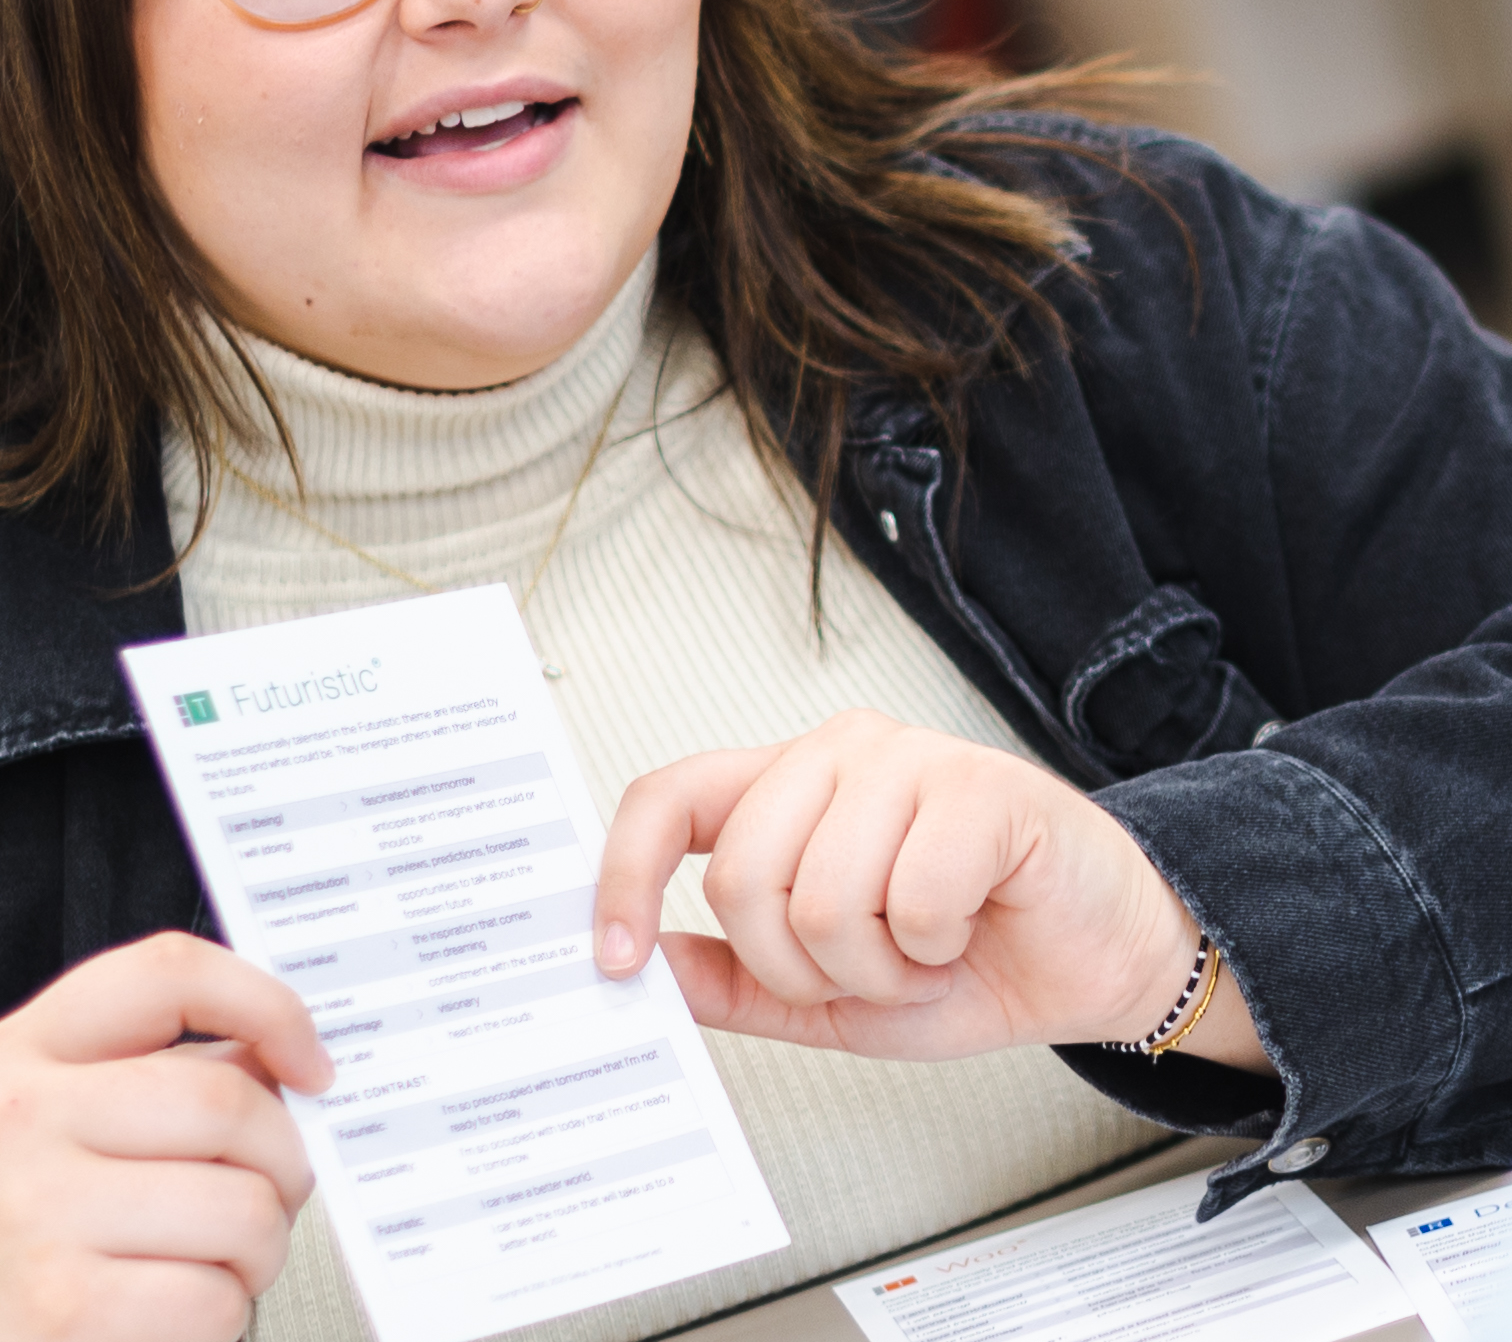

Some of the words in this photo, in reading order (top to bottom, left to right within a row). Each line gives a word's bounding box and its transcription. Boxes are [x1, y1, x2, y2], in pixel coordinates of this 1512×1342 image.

[194, 750, 230, 763] People
[229, 737, 291, 758] exceptionally
[291, 730, 331, 745] talented
[330, 728, 341, 737] in
[340, 725, 357, 735] the
[357, 717, 401, 732] Futuristic
[400, 711, 432, 723] theme
[433, 708, 448, 717] are
[449, 698, 487, 714] inspired
[485, 697, 499, 708] by
[201, 771, 220, 782] the
[219, 765, 248, 778] future
[249, 761, 268, 772] and
[268, 757, 290, 768] what
[292, 750, 320, 764] could
[335, 744, 360, 754] They
[360, 736, 400, 751] energize
[400, 730, 431, 742] others
[431, 726, 450, 736] with
[451, 721, 473, 732] their
[474, 714, 507, 728] visions
[507, 711, 517, 721] of
[360, 788, 411, 807] fascinated
[409, 785, 431, 797] with
[429, 776, 476, 792] tomorrow
[371, 816, 417, 834] anticipate
[417, 811, 437, 823] and
[436, 804, 473, 819] imagine
[473, 799, 496, 811] what
[497, 792, 525, 806] could
[524, 791, 535, 800] or
[232, 822, 251, 833] am
[243, 847, 260, 859] will
[378, 835, 411, 850] should
[409, 834, 423, 843] be
[386, 859, 431, 877] previews,
[430, 847, 486, 868] predictions,
[484, 837, 530, 854] forecasts
[258, 889, 288, 903] bring
[396, 881, 460, 902] opportunities
[458, 878, 471, 888] to
[470, 874, 488, 885] talk
[488, 867, 516, 881] about
[516, 865, 533, 875] the
[269, 915, 295, 928] need
[402, 903, 444, 919] foreseen
[444, 897, 474, 910] future
[411, 933, 429, 945] the
[428, 922, 479, 941] inspiration
[477, 917, 498, 930] that
[498, 910, 532, 925] comes
[418, 950, 442, 962] from
[442, 940, 488, 958] dreaming
[284, 960, 306, 972] love
[428, 965, 488, 988] contentment
[489, 961, 509, 973] with
[509, 957, 527, 968] the
[527, 949, 558, 964] status
[558, 945, 579, 957] quo
[437, 997, 481, 1014] visionary
[448, 1026, 473, 1039] head
[473, 1024, 482, 1033] in
[482, 1020, 500, 1031] the
[500, 1011, 534, 1026] clouds
[441, 1104, 457, 1115] I'm
[457, 1101, 472, 1112] so
[471, 1084, 534, 1110] preoccupied
[533, 1079, 555, 1091] with
[553, 1066, 603, 1085] tomorrow
[602, 1059, 624, 1072] that
[623, 1055, 641, 1066] I'm
[640, 1049, 659, 1062] not
[317, 1092, 359, 1110] THEME
[449, 1119, 478, 1133] ready
[476, 1114, 492, 1126] for
[475, 1144, 490, 1154] so
[489, 1130, 537, 1151] occupied
[536, 1125, 555, 1137] with
[557, 1118, 586, 1132] today
[586, 1111, 606, 1123] that
[606, 1106, 624, 1118] I'm
[623, 1101, 642, 1113] not
[642, 1093, 671, 1108] ready
[466, 1164, 481, 1176] for
[485, 1196, 505, 1208] can
[505, 1191, 524, 1203] see
[525, 1188, 533, 1198] a
[532, 1180, 562, 1195] better
[496, 1221, 514, 1233] can
[516, 1216, 534, 1228] see
[534, 1211, 553, 1222] the
[552, 1203, 580, 1217] route
[579, 1197, 600, 1209] that
[601, 1191, 618, 1203] will
[617, 1186, 640, 1199] take
[642, 1182, 655, 1192] us
[654, 1178, 667, 1188] to
[667, 1176, 675, 1185] a
